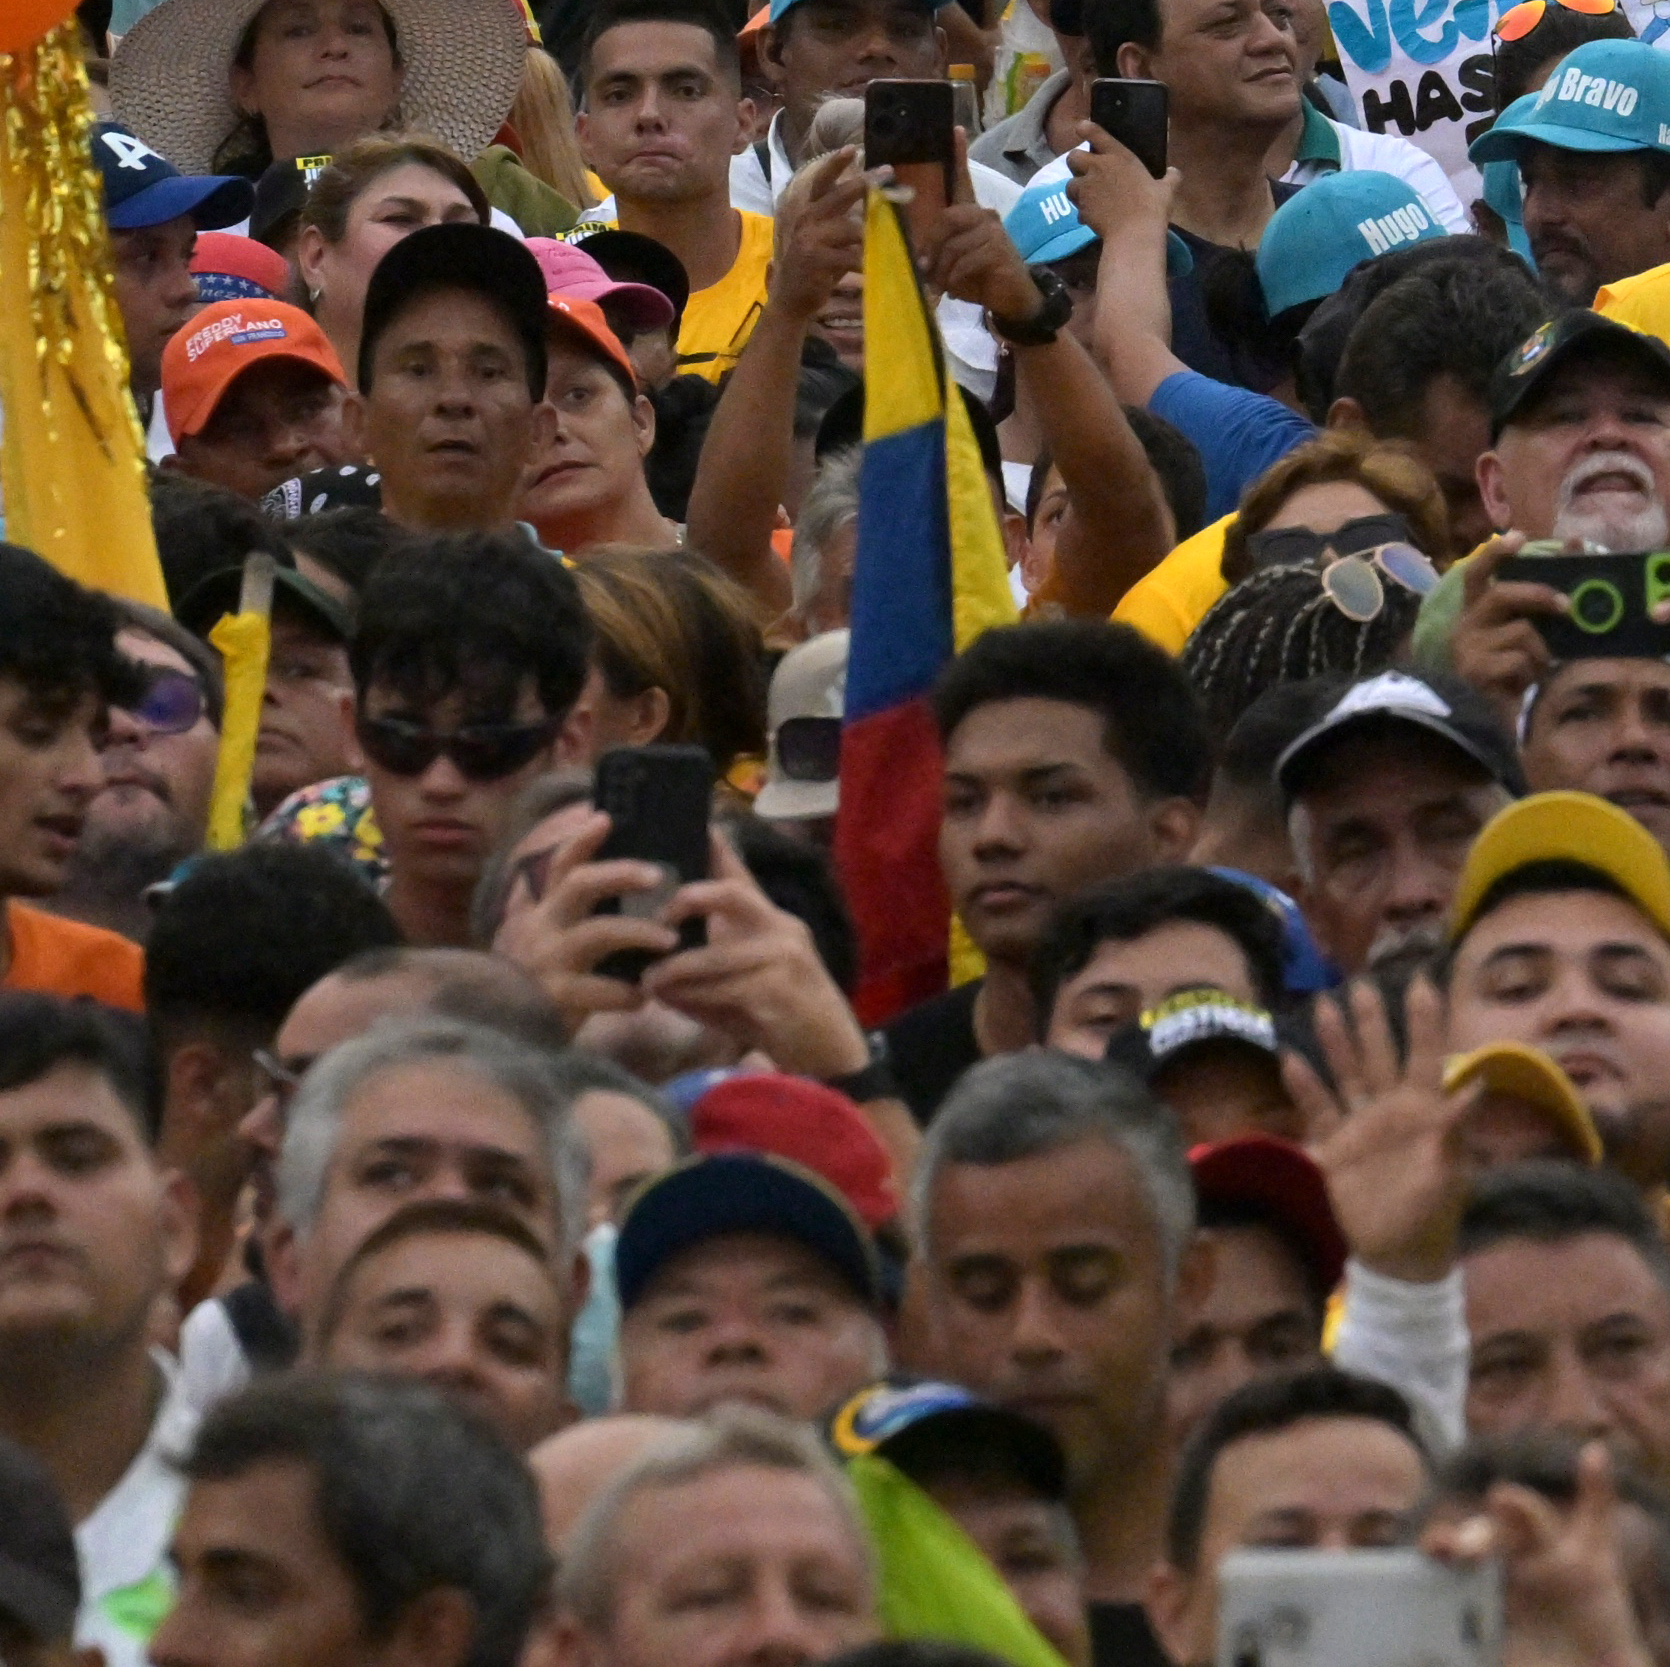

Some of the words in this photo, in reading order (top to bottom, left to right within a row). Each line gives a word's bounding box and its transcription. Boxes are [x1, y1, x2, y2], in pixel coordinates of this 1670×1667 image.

[1557, 67, 1638, 117] Bravo
[1358, 201, 1430, 256] Hugo
[186, 314, 242, 351] FREDDY
[188, 319, 283, 363] SUPERLANO
